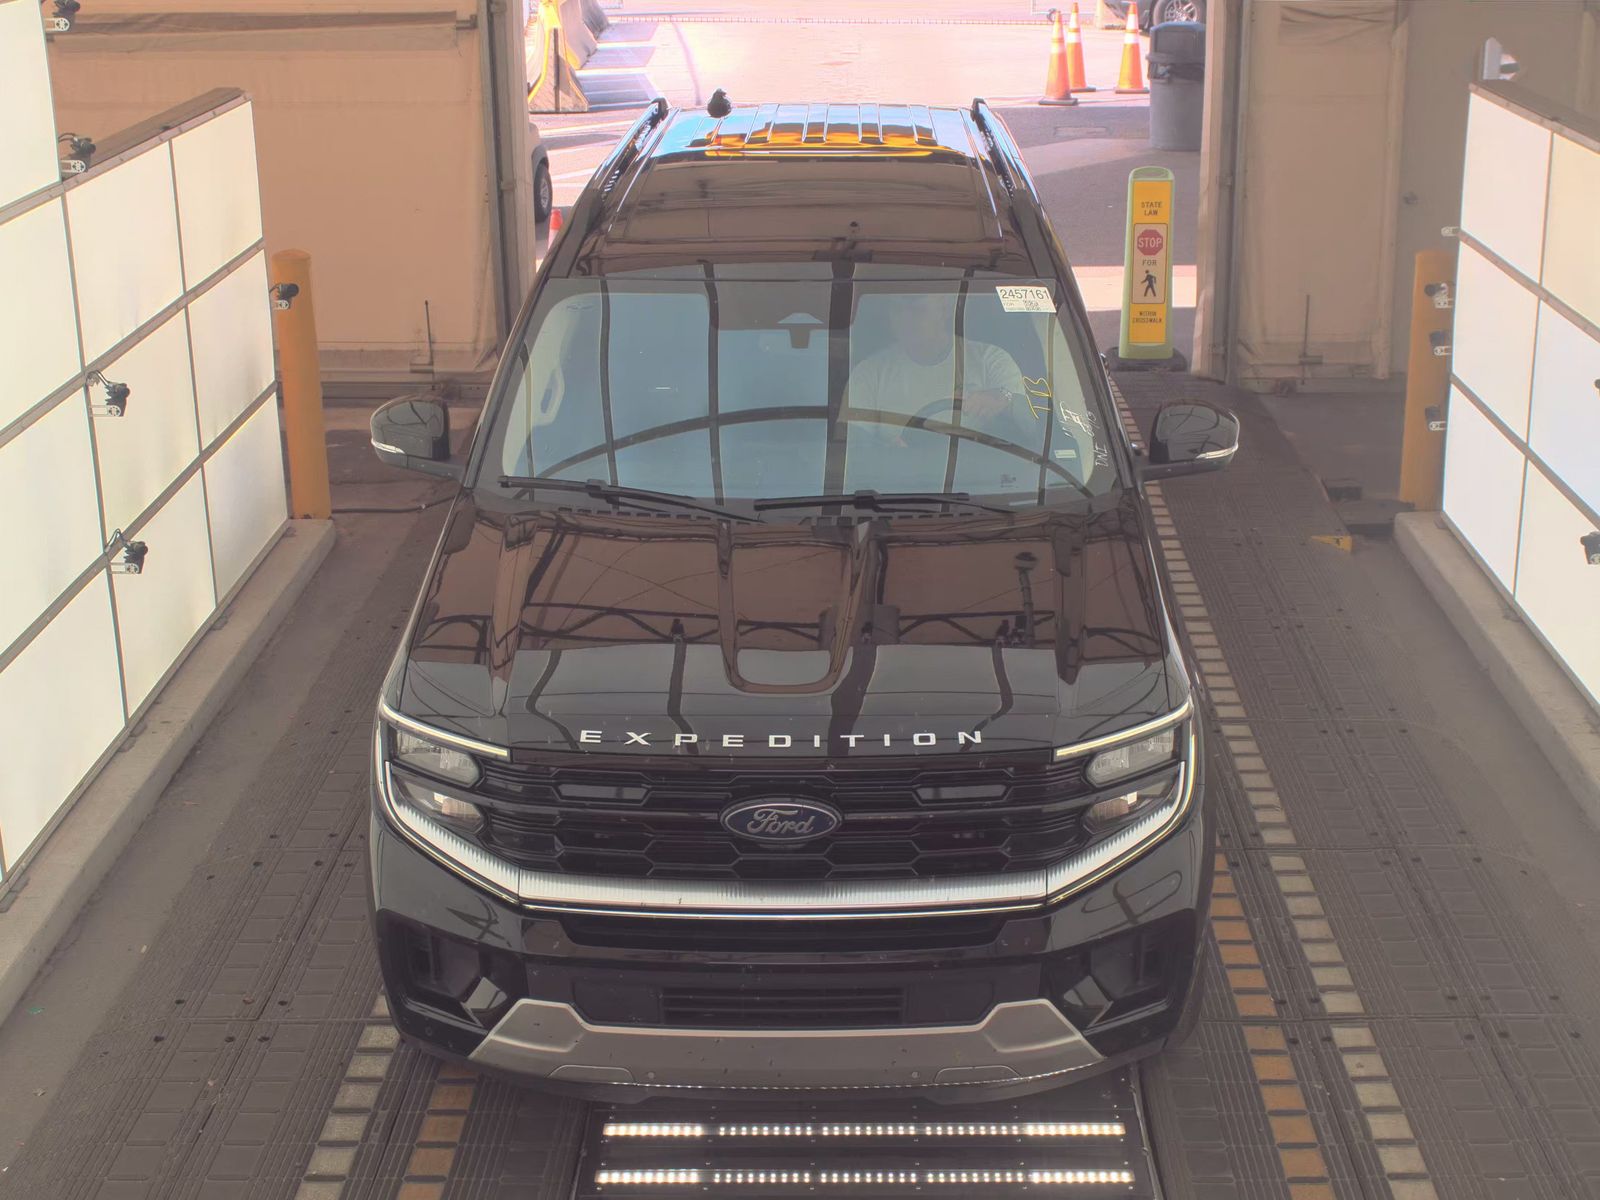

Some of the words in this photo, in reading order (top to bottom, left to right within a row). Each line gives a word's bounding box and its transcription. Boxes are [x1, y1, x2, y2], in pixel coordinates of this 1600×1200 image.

[1137, 237, 1162, 249] STOP
[999, 289, 1050, 300] 2457161
[579, 729, 982, 748] EXPEDITION
[747, 807, 814, 834] Ford
